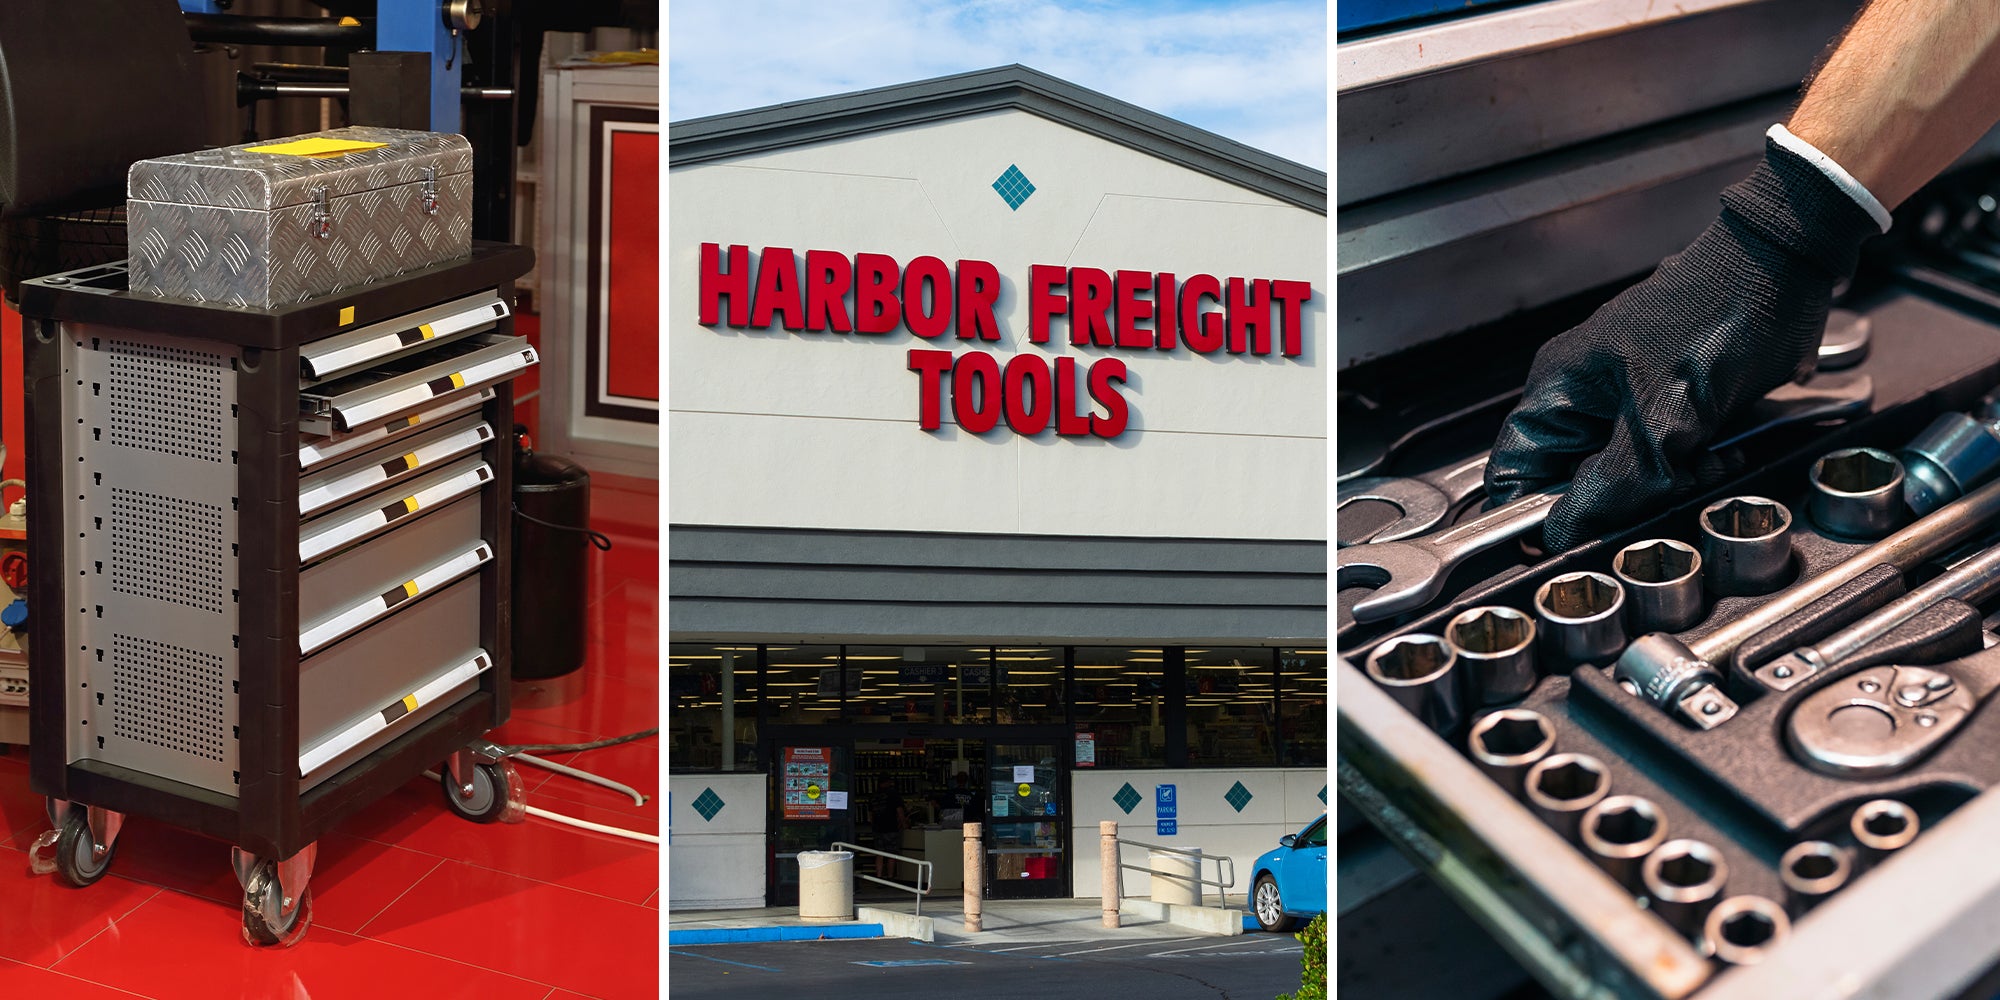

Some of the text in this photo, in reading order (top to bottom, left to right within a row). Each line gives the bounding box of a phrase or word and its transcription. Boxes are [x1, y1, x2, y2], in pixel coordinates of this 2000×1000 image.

[698, 242, 1312, 356] HARBOR FREIGHT
[908, 349, 1129, 437] TOOLS
[904, 667, 936, 677] CASHIER
[963, 668, 992, 677] CASHIE
[1157, 806, 1176, 814] PARKING
